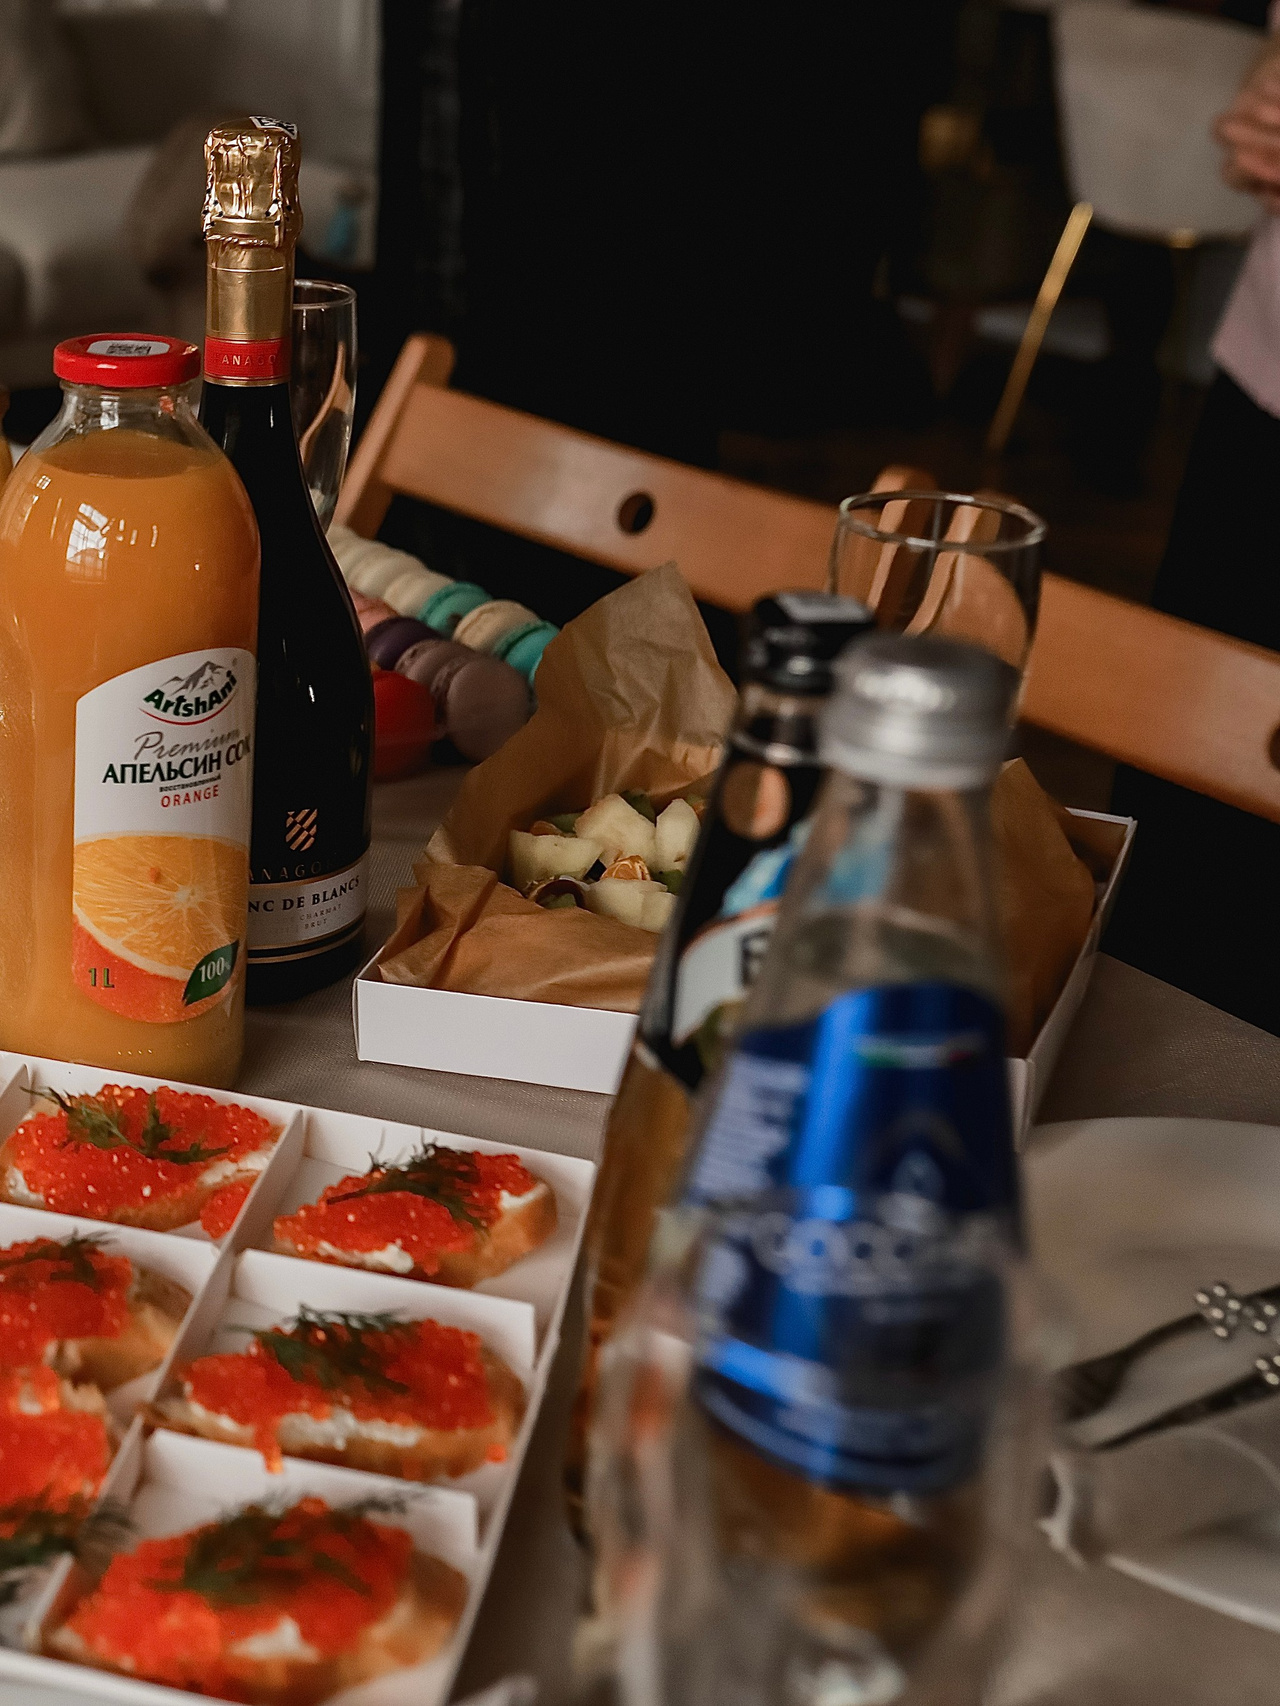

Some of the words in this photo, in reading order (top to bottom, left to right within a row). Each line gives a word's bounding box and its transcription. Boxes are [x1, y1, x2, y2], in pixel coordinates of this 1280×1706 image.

[143, 670, 237, 717] ArtshAni
[134, 729, 240, 761] Premium
[102, 751, 220, 784] АПЕЛЬСИН
[161, 785, 219, 807] ORANGE
[282, 896, 305, 911] DE
[311, 875, 360, 906] BLANCS
